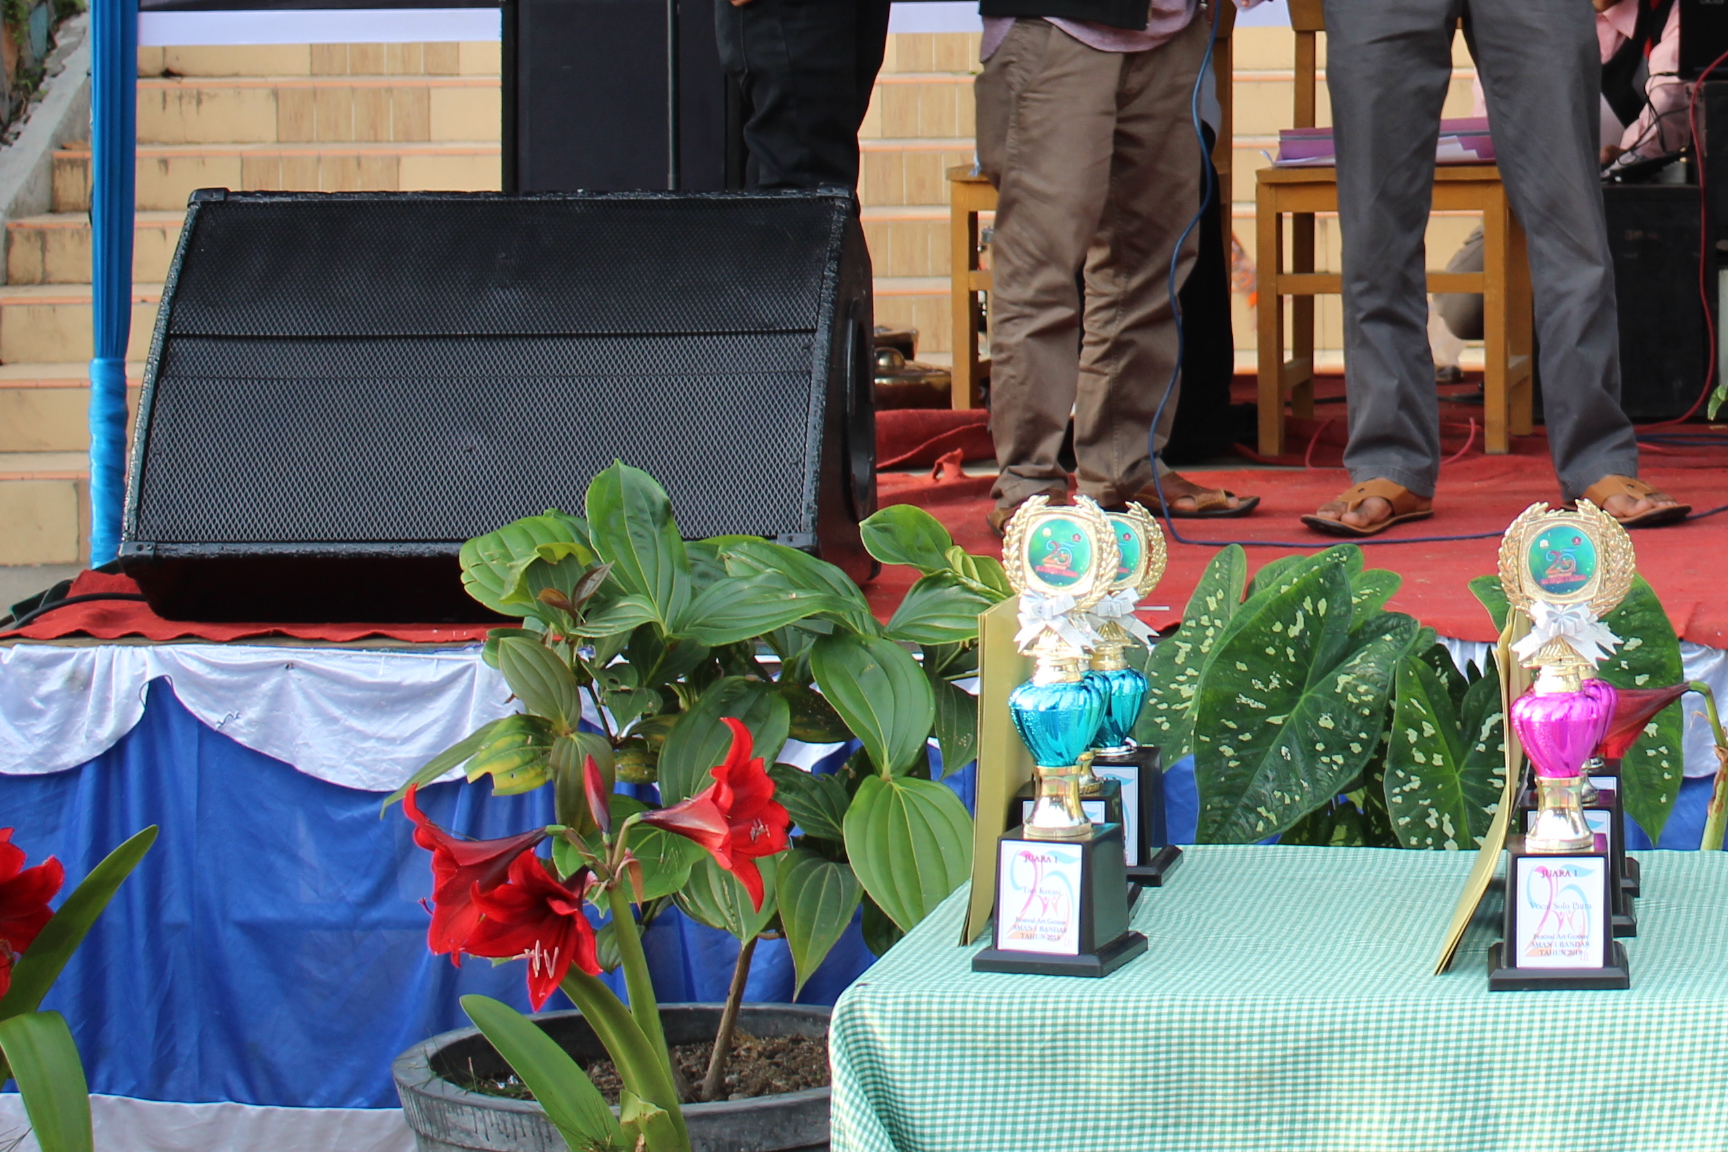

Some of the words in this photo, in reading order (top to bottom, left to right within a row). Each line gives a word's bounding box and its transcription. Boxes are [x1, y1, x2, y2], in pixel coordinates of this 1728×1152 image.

[1023, 854, 1052, 863] JUARA
[1541, 869, 1571, 879] JUARA
[1039, 925, 1067, 933] BANDAR
